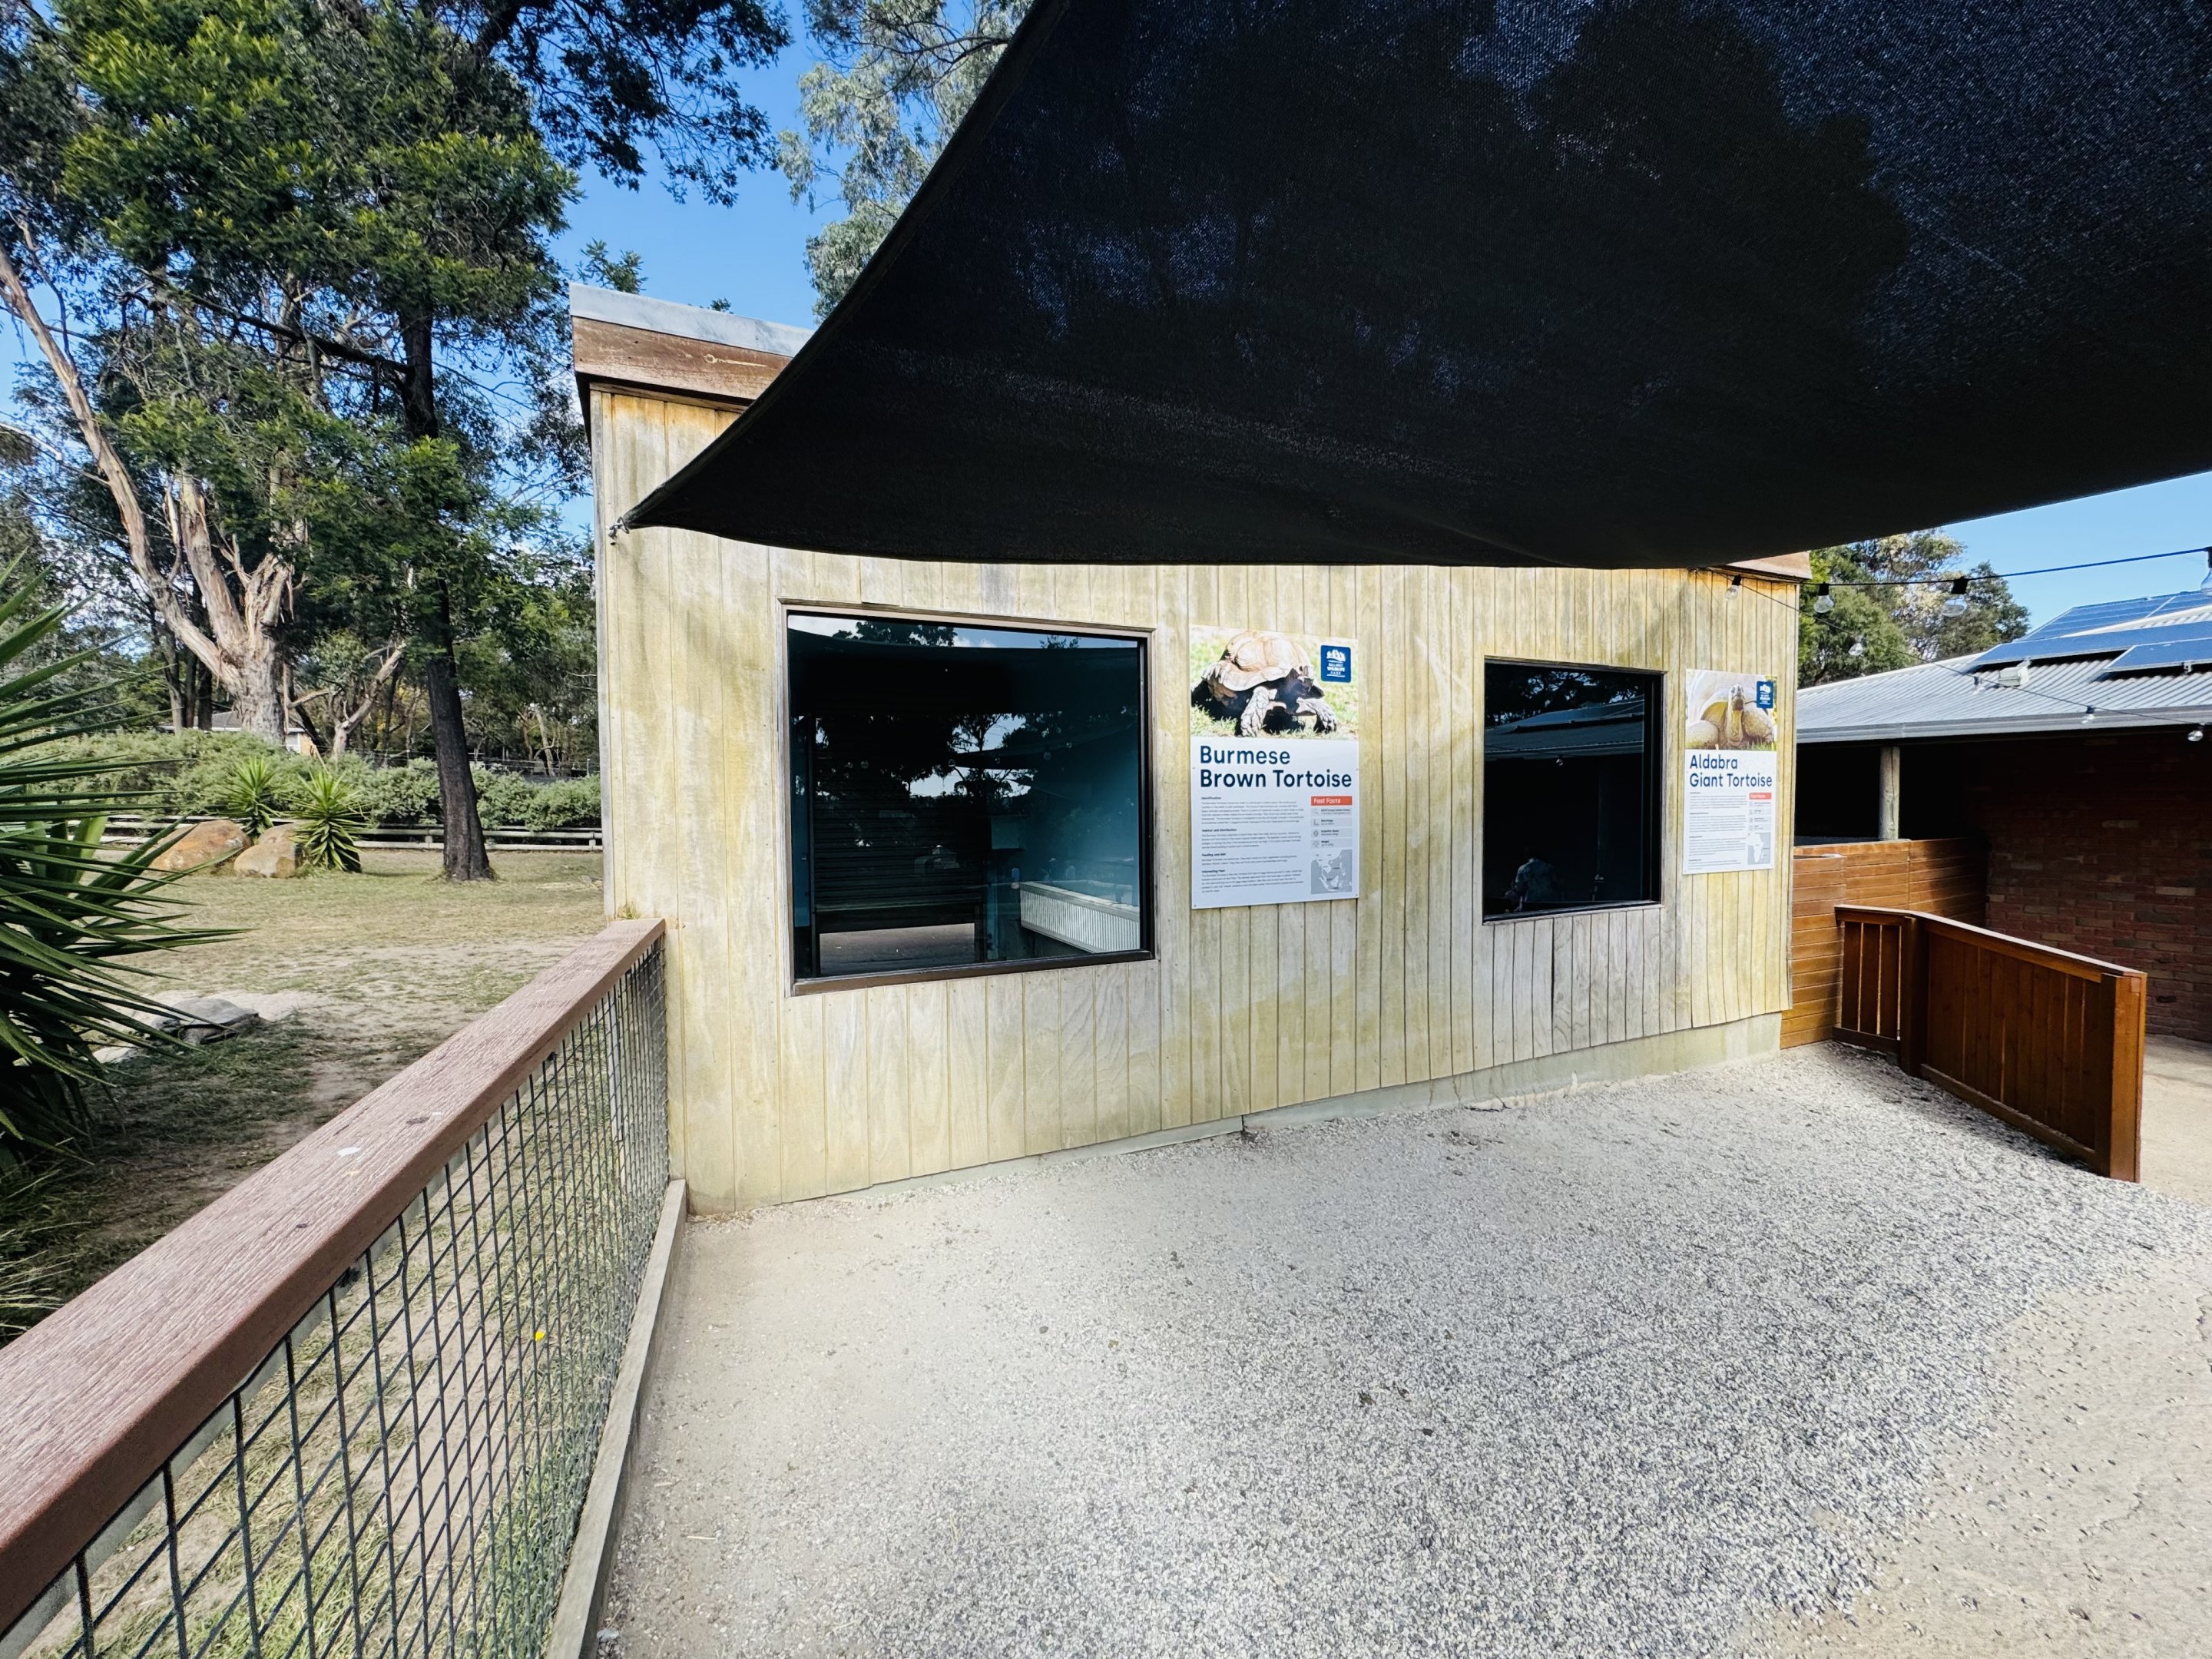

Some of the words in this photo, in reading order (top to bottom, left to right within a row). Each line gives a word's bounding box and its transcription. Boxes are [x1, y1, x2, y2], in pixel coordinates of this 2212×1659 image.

[1200, 745, 1290, 765] Burmese
[1690, 753, 1738, 769] Aldabra
[1200, 769, 1267, 788] Brown
[1273, 769, 1353, 788] Tortoise
[1690, 773, 1724, 787] Giant
[1727, 773, 1773, 787] Tortoise
